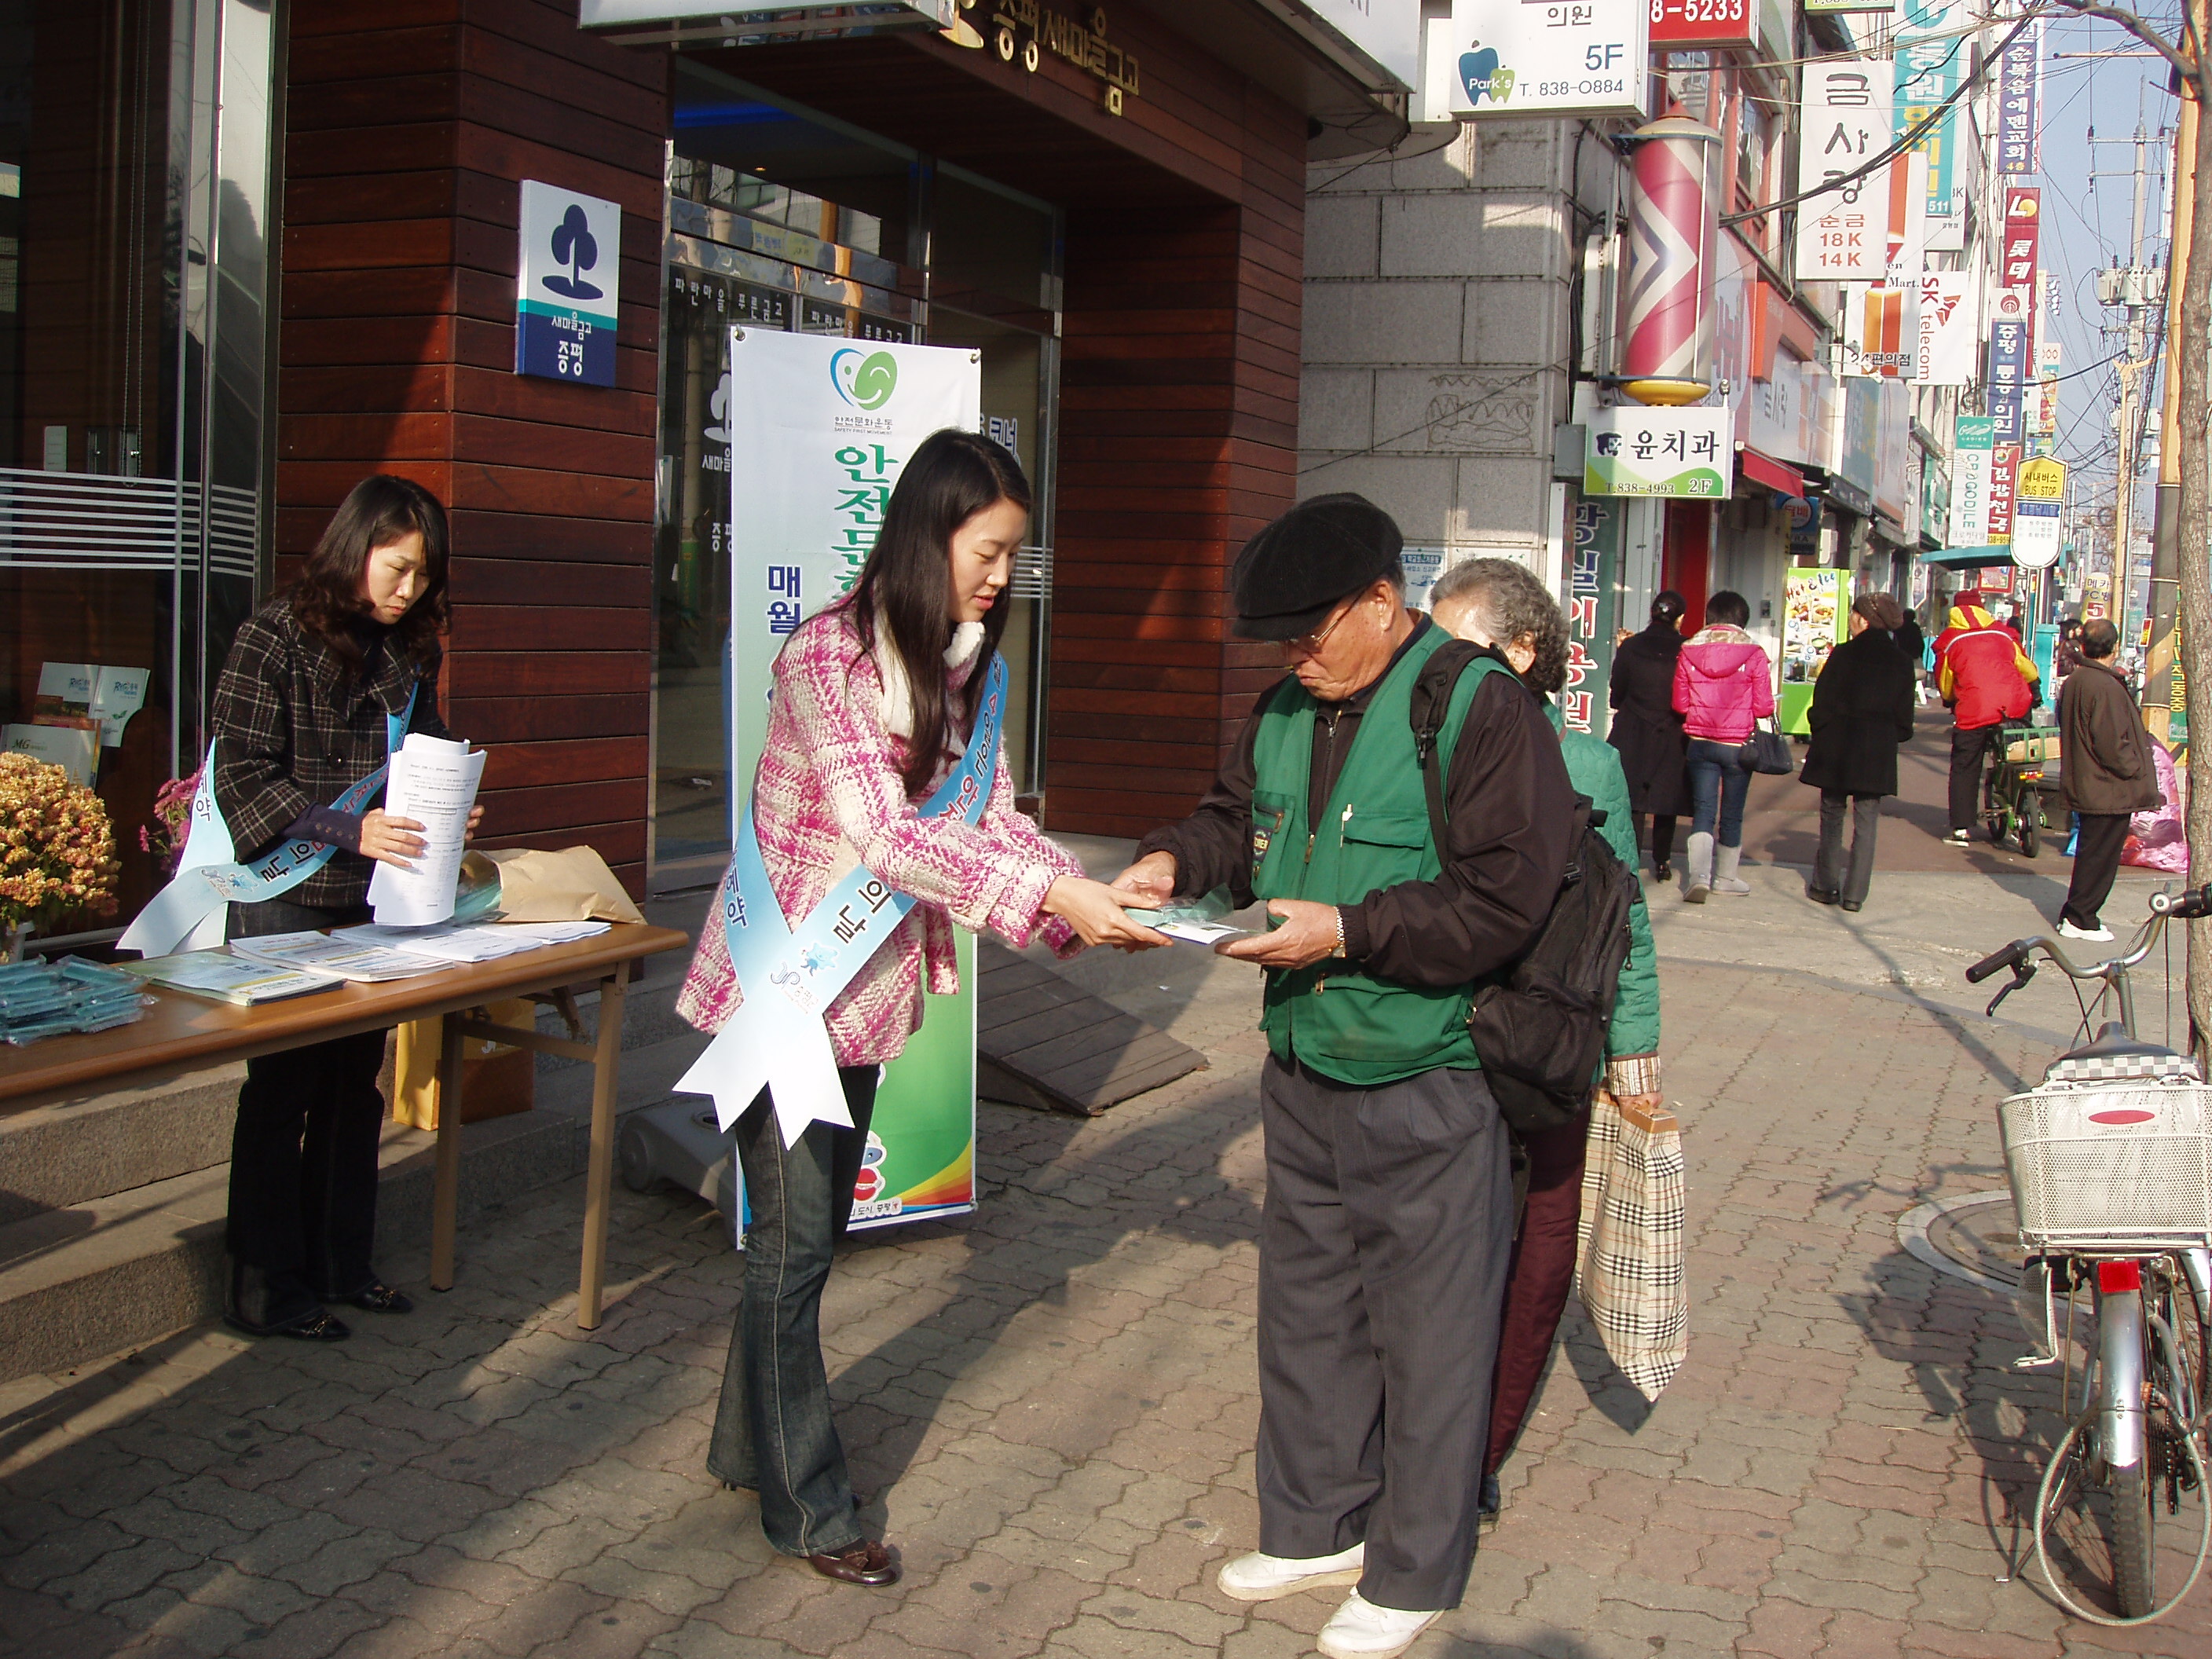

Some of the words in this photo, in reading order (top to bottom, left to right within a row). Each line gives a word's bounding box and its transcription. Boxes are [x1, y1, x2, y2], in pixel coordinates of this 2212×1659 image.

[1547, 5, 1593, 27] 의원
[1043, 7, 1139, 117] 새마을금고
[1585, 44, 1624, 71] 5F
[1469, 76, 1512, 91] Park's
[1822, 73, 1871, 204] 금사랑
[1819, 214, 1865, 229] 순금
[1888, 276, 1920, 288] Mart.
[1921, 276, 1939, 304] SK
[675, 277, 725, 313] 파란마을
[738, 293, 782, 323] 푸른금고
[551, 311, 592, 341] 새마을금고
[558, 340, 583, 376] 증평
[1920, 314, 1935, 380] telecom
[834, 416, 893, 430] 안전문화운동
[1631, 430, 1720, 463] 윤치과
[1689, 479, 1712, 493] 2F
[2024, 472, 2058, 483] 시내버스
[2024, 485, 2037, 496] BUS
[2040, 485, 2057, 496] STOP
[1989, 465, 2012, 533] 김밥천국
[767, 565, 801, 635] 매월
